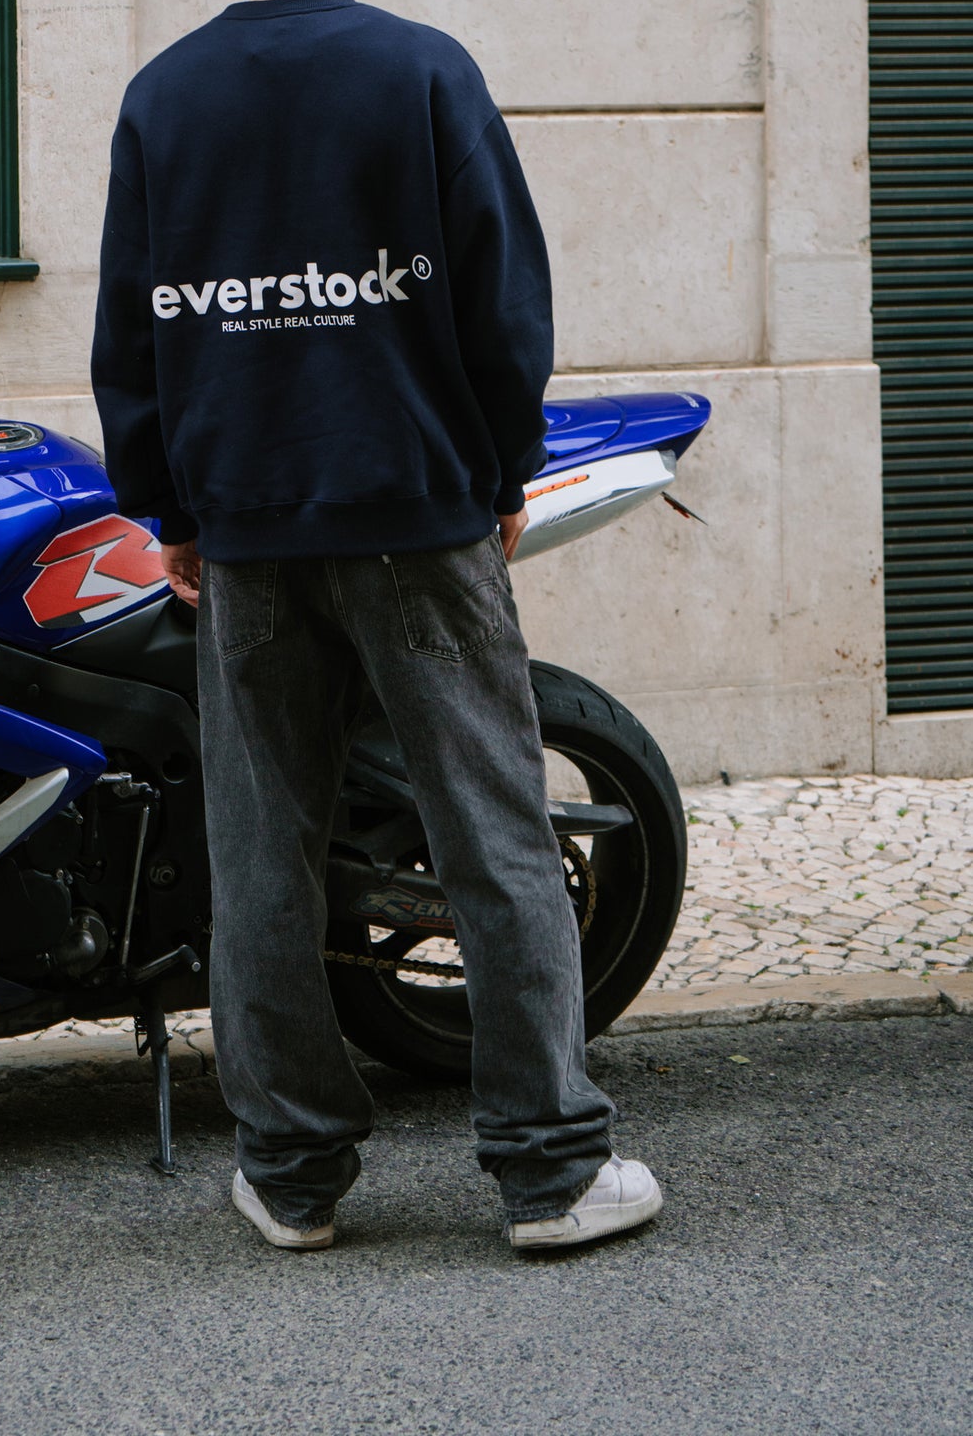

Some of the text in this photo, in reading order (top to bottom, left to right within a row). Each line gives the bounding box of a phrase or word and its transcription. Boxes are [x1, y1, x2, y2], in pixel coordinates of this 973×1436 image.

[221, 314, 356, 333] REAL STYLE REAL CULTURE
